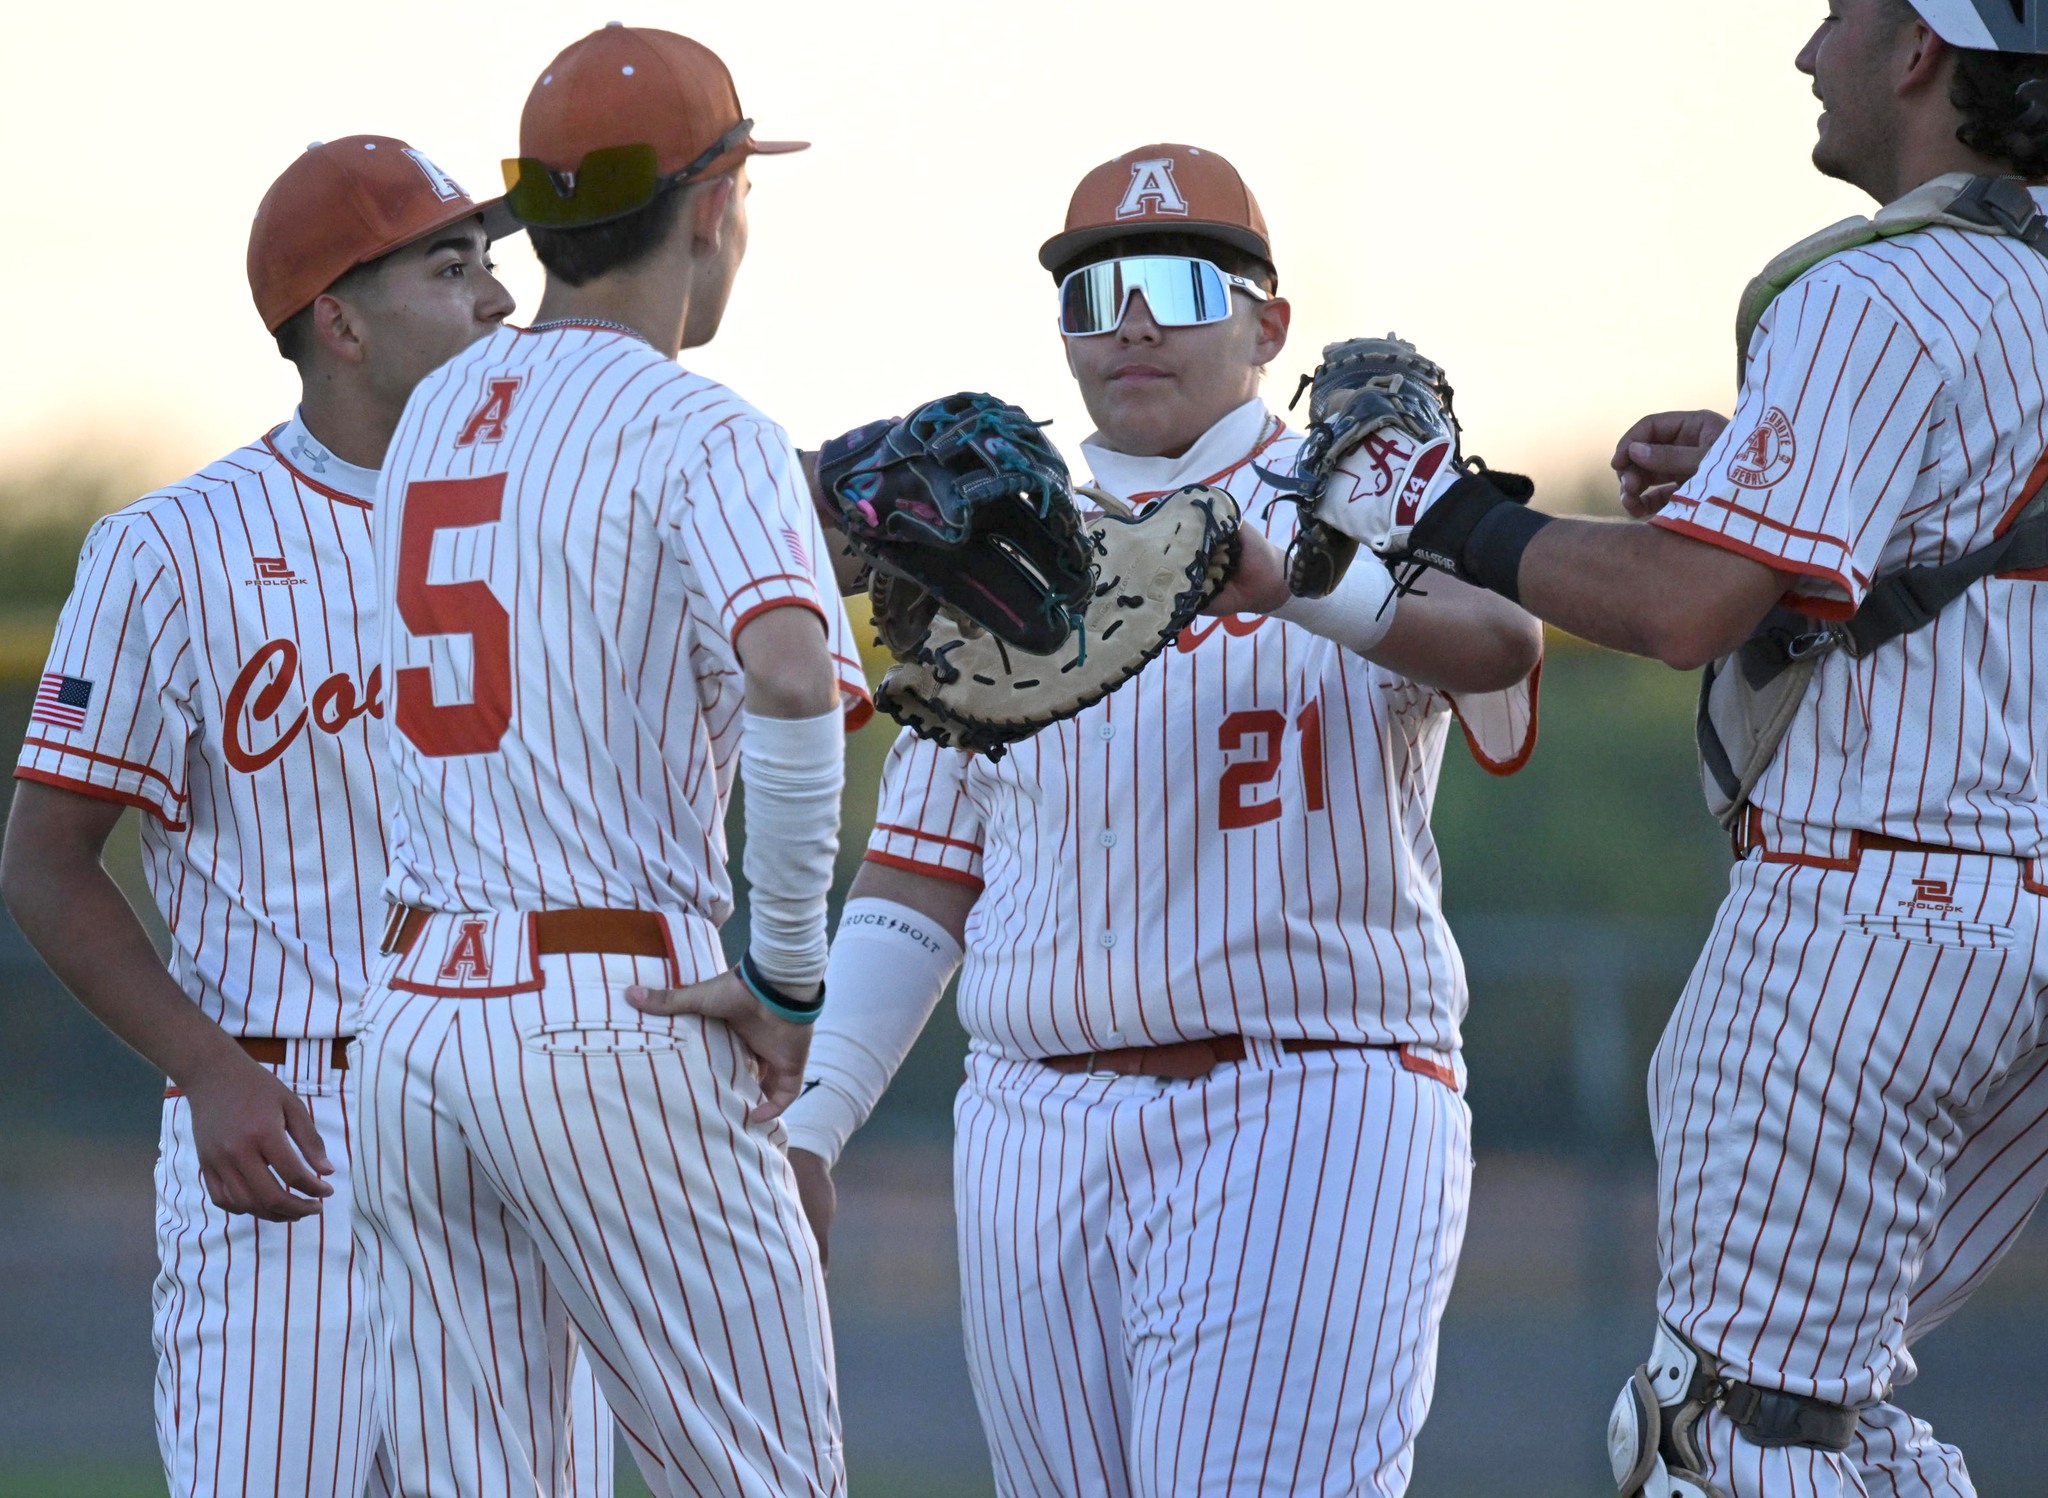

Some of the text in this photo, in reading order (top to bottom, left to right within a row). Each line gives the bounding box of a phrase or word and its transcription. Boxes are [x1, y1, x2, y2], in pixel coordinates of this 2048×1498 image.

[401, 148, 470, 203] A
[1116, 158, 1188, 221] A
[453, 376, 523, 449] A
[1735, 427, 1772, 469] A
[1402, 476, 1427, 507] 44
[245, 579, 308, 587] PROLOOK
[394, 471, 511, 758] 5
[1218, 695, 1325, 830] 21
[841, 914, 940, 953] RUCE BOLT
[1898, 900, 1963, 913] PROLOOK
[438, 919, 492, 980] A
